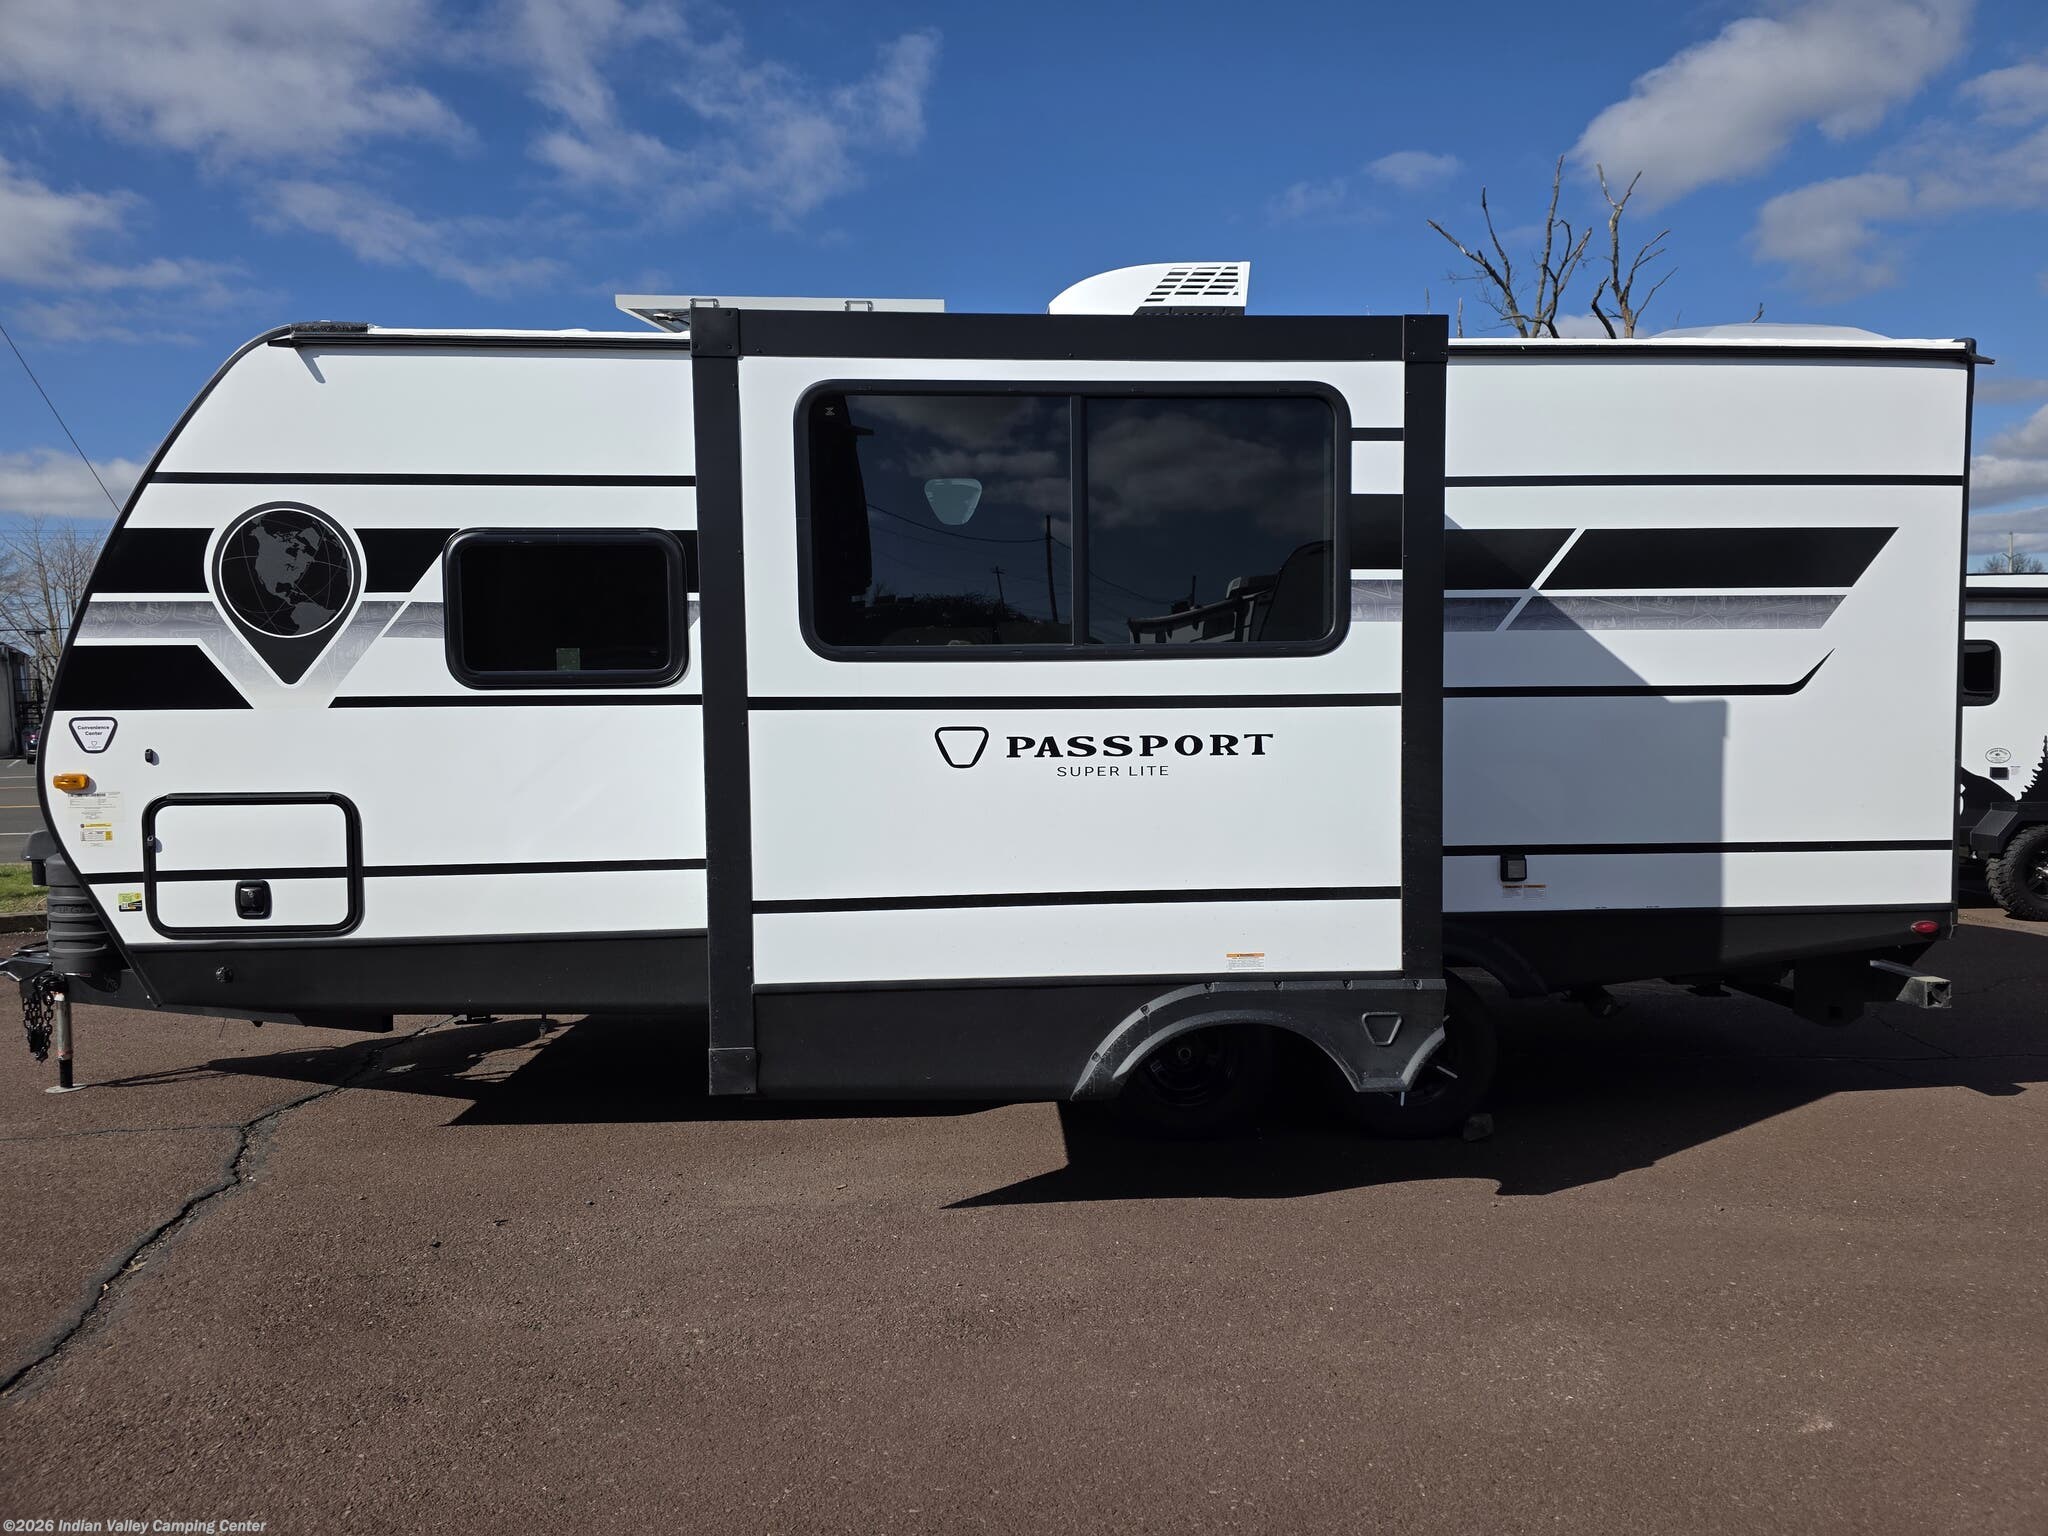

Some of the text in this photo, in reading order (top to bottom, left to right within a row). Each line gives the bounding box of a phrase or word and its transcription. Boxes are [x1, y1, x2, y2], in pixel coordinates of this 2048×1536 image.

[1006, 733, 1274, 758] PASSPORT
[1056, 765, 1169, 777] SUPER LITE
